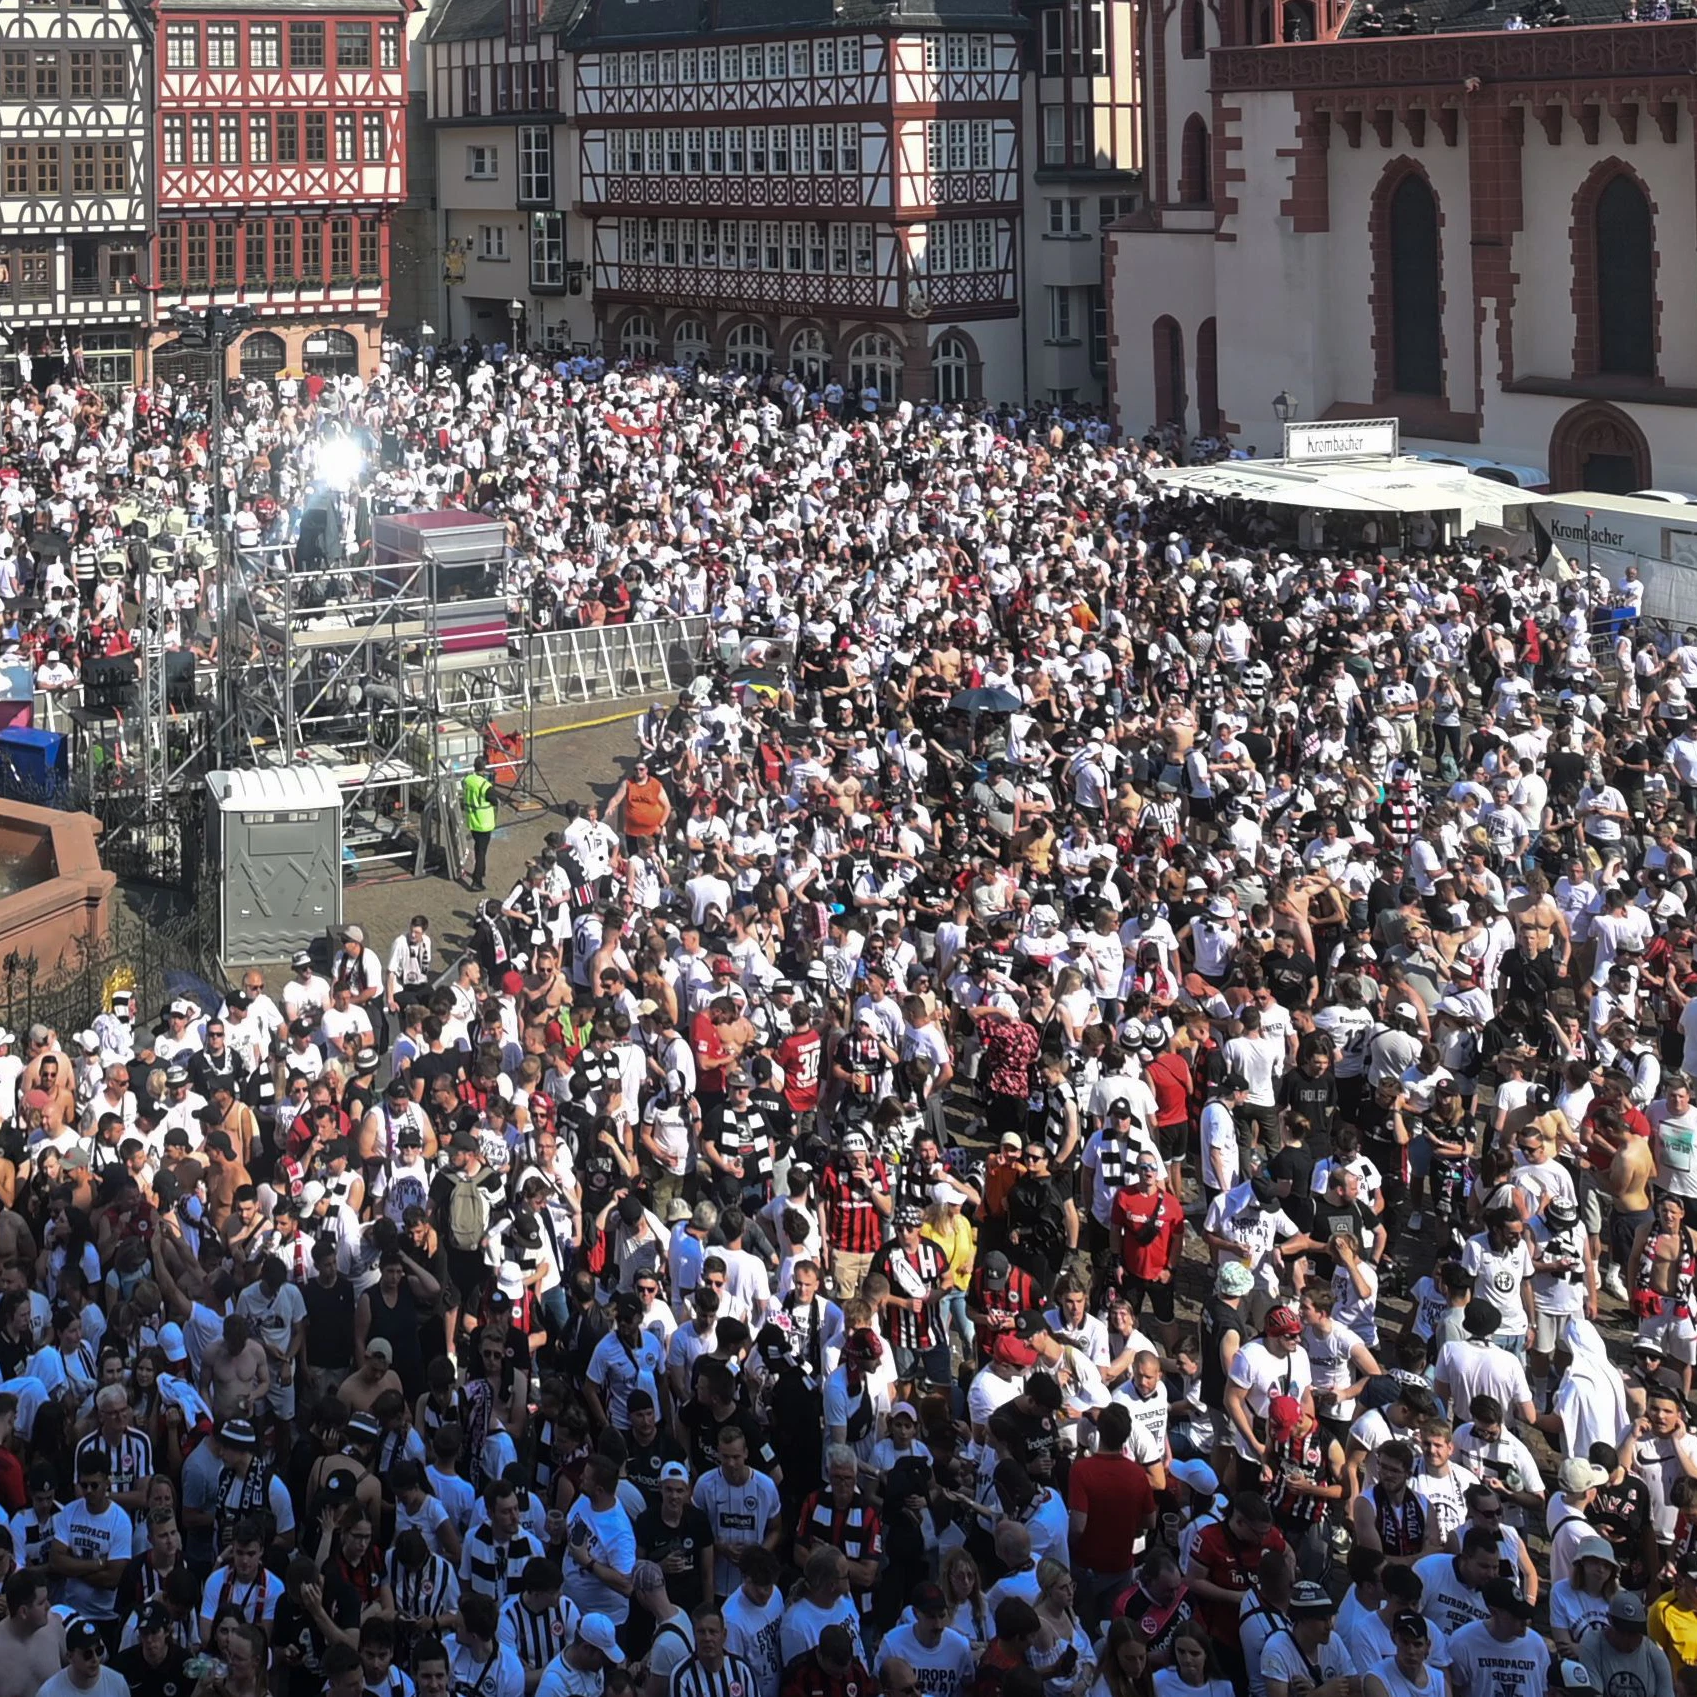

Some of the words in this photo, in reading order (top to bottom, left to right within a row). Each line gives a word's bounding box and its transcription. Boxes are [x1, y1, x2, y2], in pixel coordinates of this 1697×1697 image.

[654, 294, 714, 310] RESTAURANT
[717, 297, 775, 313] SCHWARZER
[778, 301, 815, 317] STERN
[1307, 435, 1364, 453] Krombacher
[797, 1049, 821, 1080] 30
[1478, 1658, 1536, 1672] EUROPACUP
[913, 1668, 957, 1682] UROPA
[1492, 1671, 1526, 1685] SIEGER
